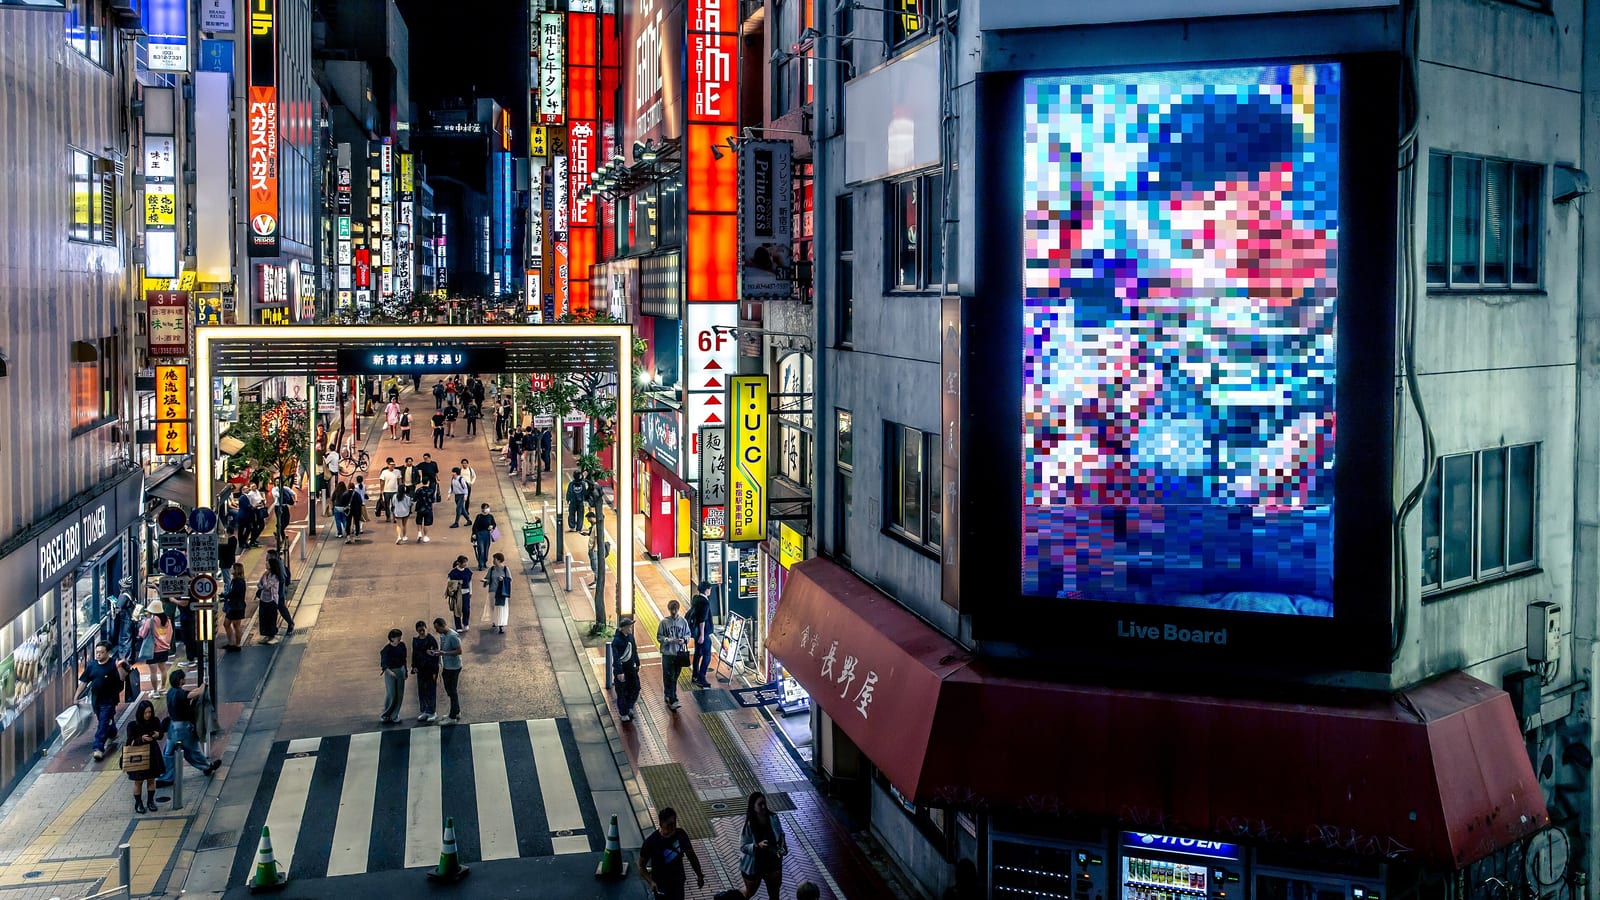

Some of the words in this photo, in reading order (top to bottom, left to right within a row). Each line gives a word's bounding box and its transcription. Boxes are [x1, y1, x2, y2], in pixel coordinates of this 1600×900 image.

[251, 102, 268, 190] ベガスベガス
[756, 160, 768, 230] Princess
[698, 331, 728, 351] 6F
[372, 354, 463, 366] 新宿武蔵野通り
[319, 384, 335, 393] 新宿
[163, 368, 181, 453] 俺流塩らーめん
[744, 490, 754, 526] SHOP
[40, 522, 80, 584] PASELABO
[83, 505, 107, 549] TOWER
[165, 557, 176, 573] P
[196, 581, 212, 593] 30
[1117, 620, 1160, 640] Live
[1164, 623, 1228, 645] Board
[820, 640, 879, 720] 長野屋
